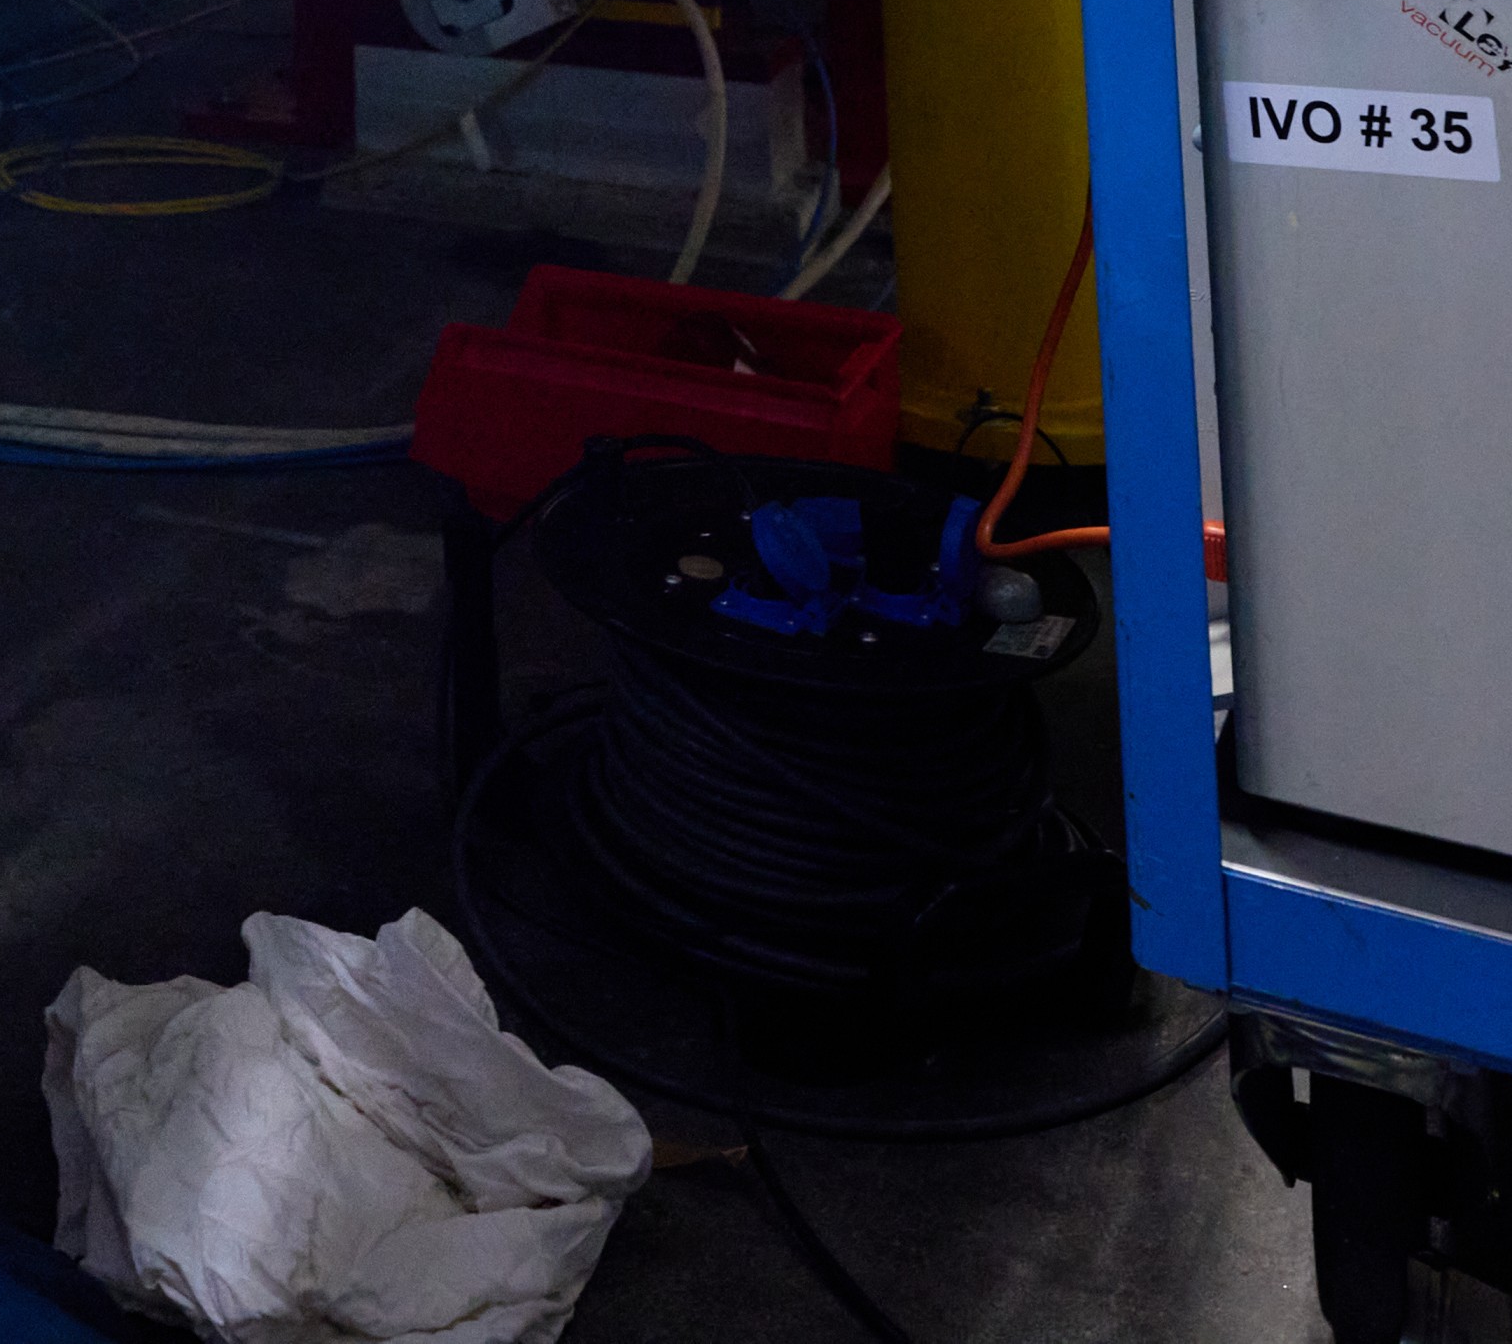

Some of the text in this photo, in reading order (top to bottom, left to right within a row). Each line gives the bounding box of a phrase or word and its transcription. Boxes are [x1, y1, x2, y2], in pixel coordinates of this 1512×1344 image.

[1400, 0, 1496, 77] vacuum
[1249, 96, 1473, 154] IVO # 35
